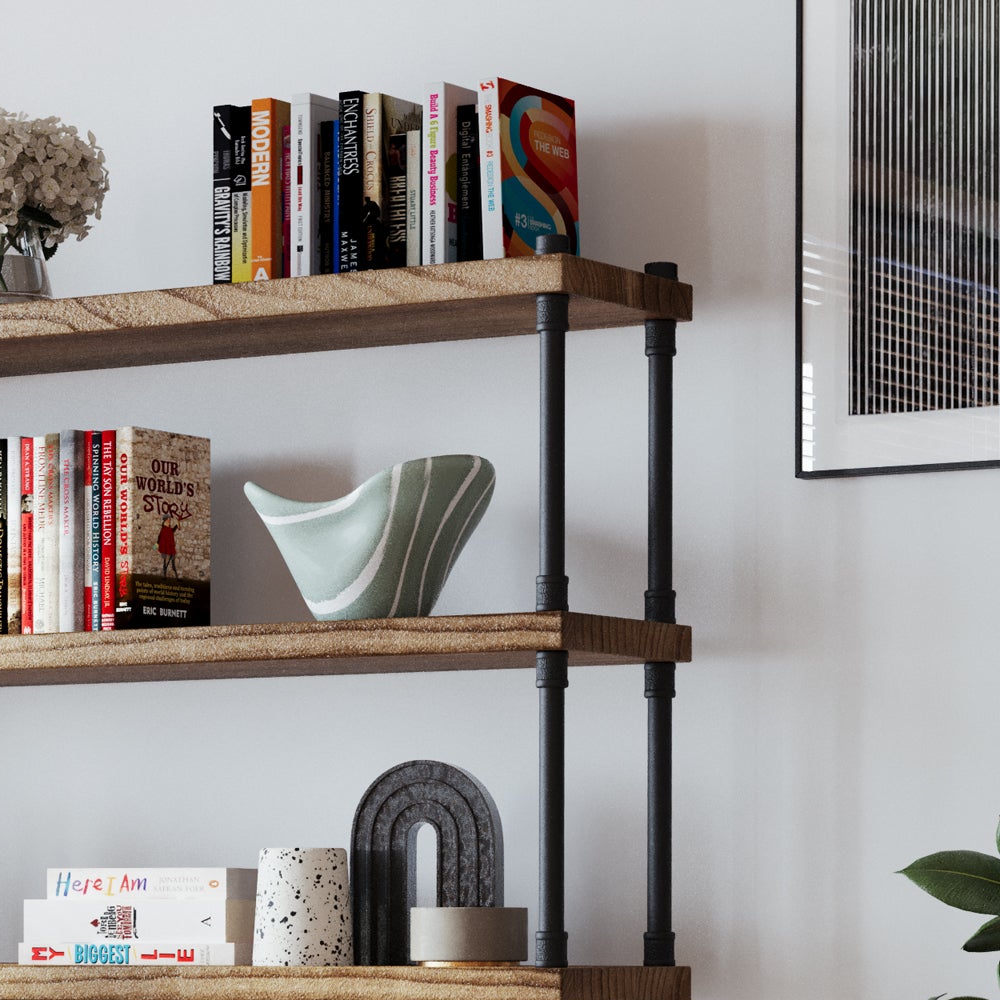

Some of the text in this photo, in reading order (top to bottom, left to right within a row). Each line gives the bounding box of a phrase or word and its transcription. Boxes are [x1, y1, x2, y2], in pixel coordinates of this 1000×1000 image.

[430, 94, 438, 112] Build
[252, 110, 270, 186] MODERN
[343, 98, 359, 175] ENCHANTRESS
[429, 127, 438, 148] Figure
[365, 109, 376, 190] SHIELD CROCUS
[535, 140, 569, 159] THE WEB
[428, 150, 438, 174] Beauty
[459, 122, 470, 209] Digital Entanglement
[430, 176, 438, 205] Business
[214, 186, 230, 280] GRAVITY'S RAINBOW
[104, 441, 112, 458] THE
[152, 459, 179, 476] OUR
[136, 476, 194, 497] WORLD'S
[120, 454, 128, 555] OUR WORLD'S
[104, 499, 112, 545] REBELLION
[143, 606, 187, 618] ERIC BURNETT
[56, 872, 147, 896] Here I Am
[75, 944, 131, 964] BIGGEST
